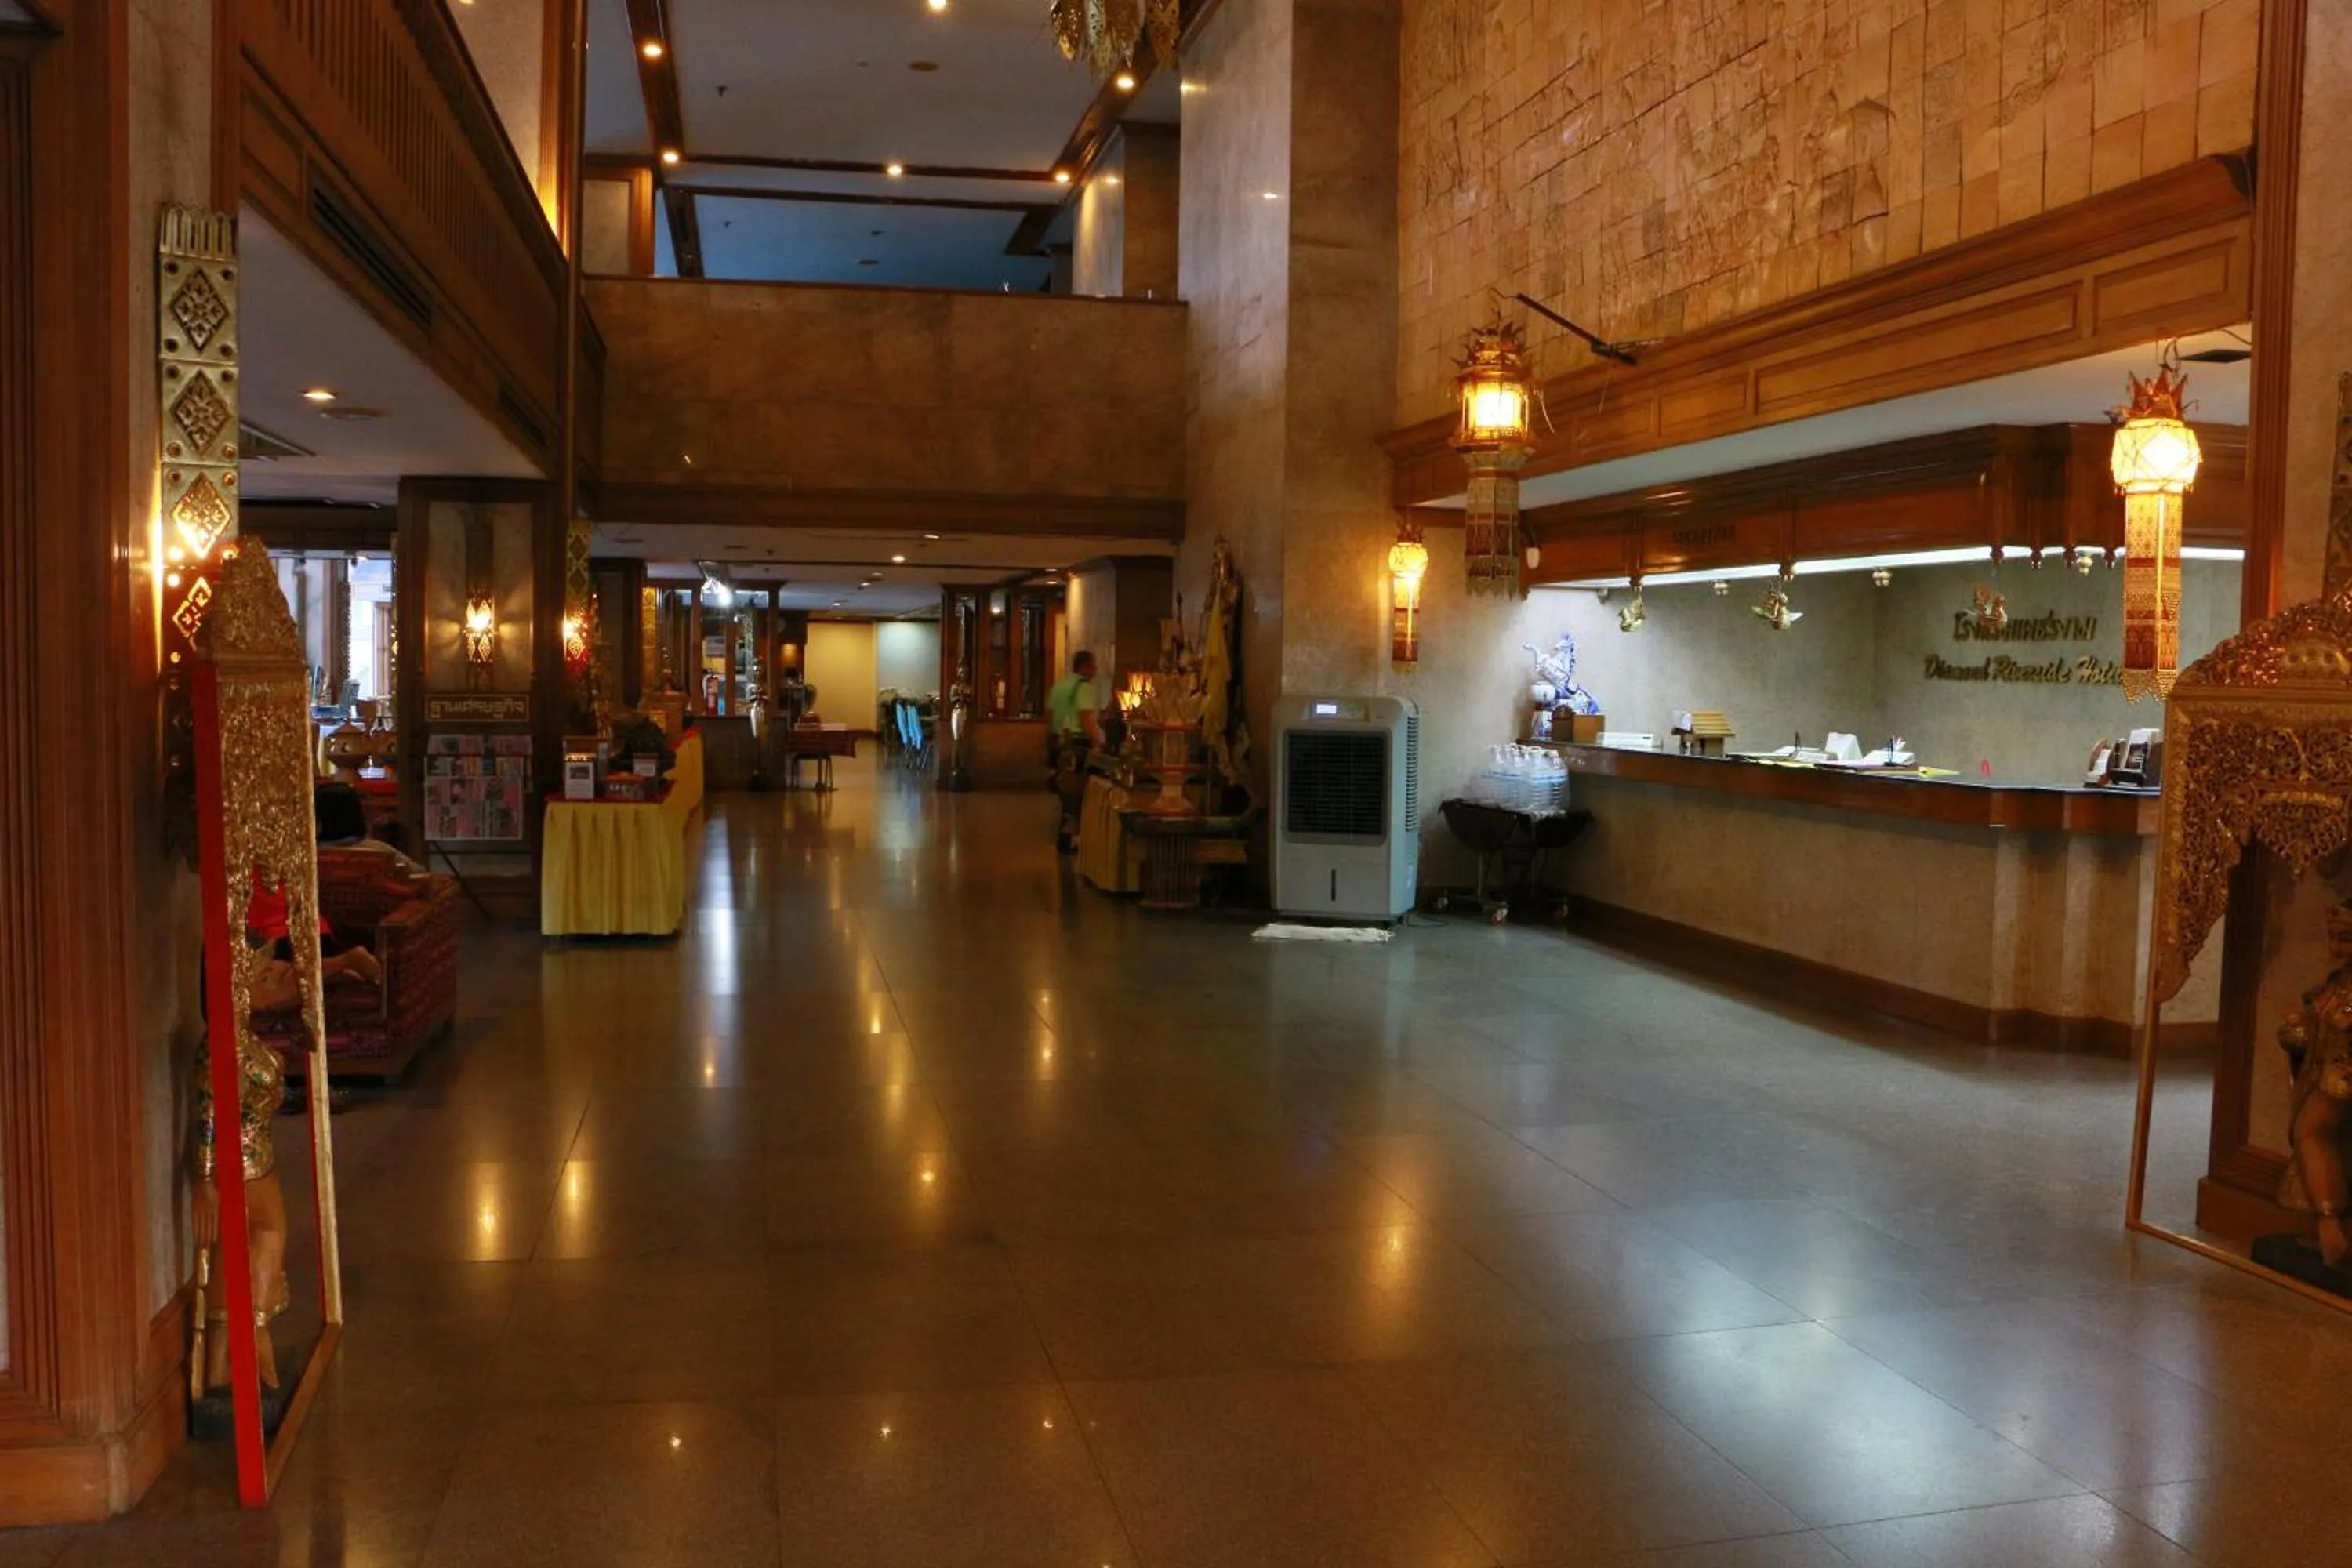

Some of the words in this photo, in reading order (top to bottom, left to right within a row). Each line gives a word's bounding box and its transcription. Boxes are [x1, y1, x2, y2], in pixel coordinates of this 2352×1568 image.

[1923, 653, 1991, 681] Diamond
[1992, 654, 2072, 684] Riverside
[2076, 655, 2121, 685] Hote
